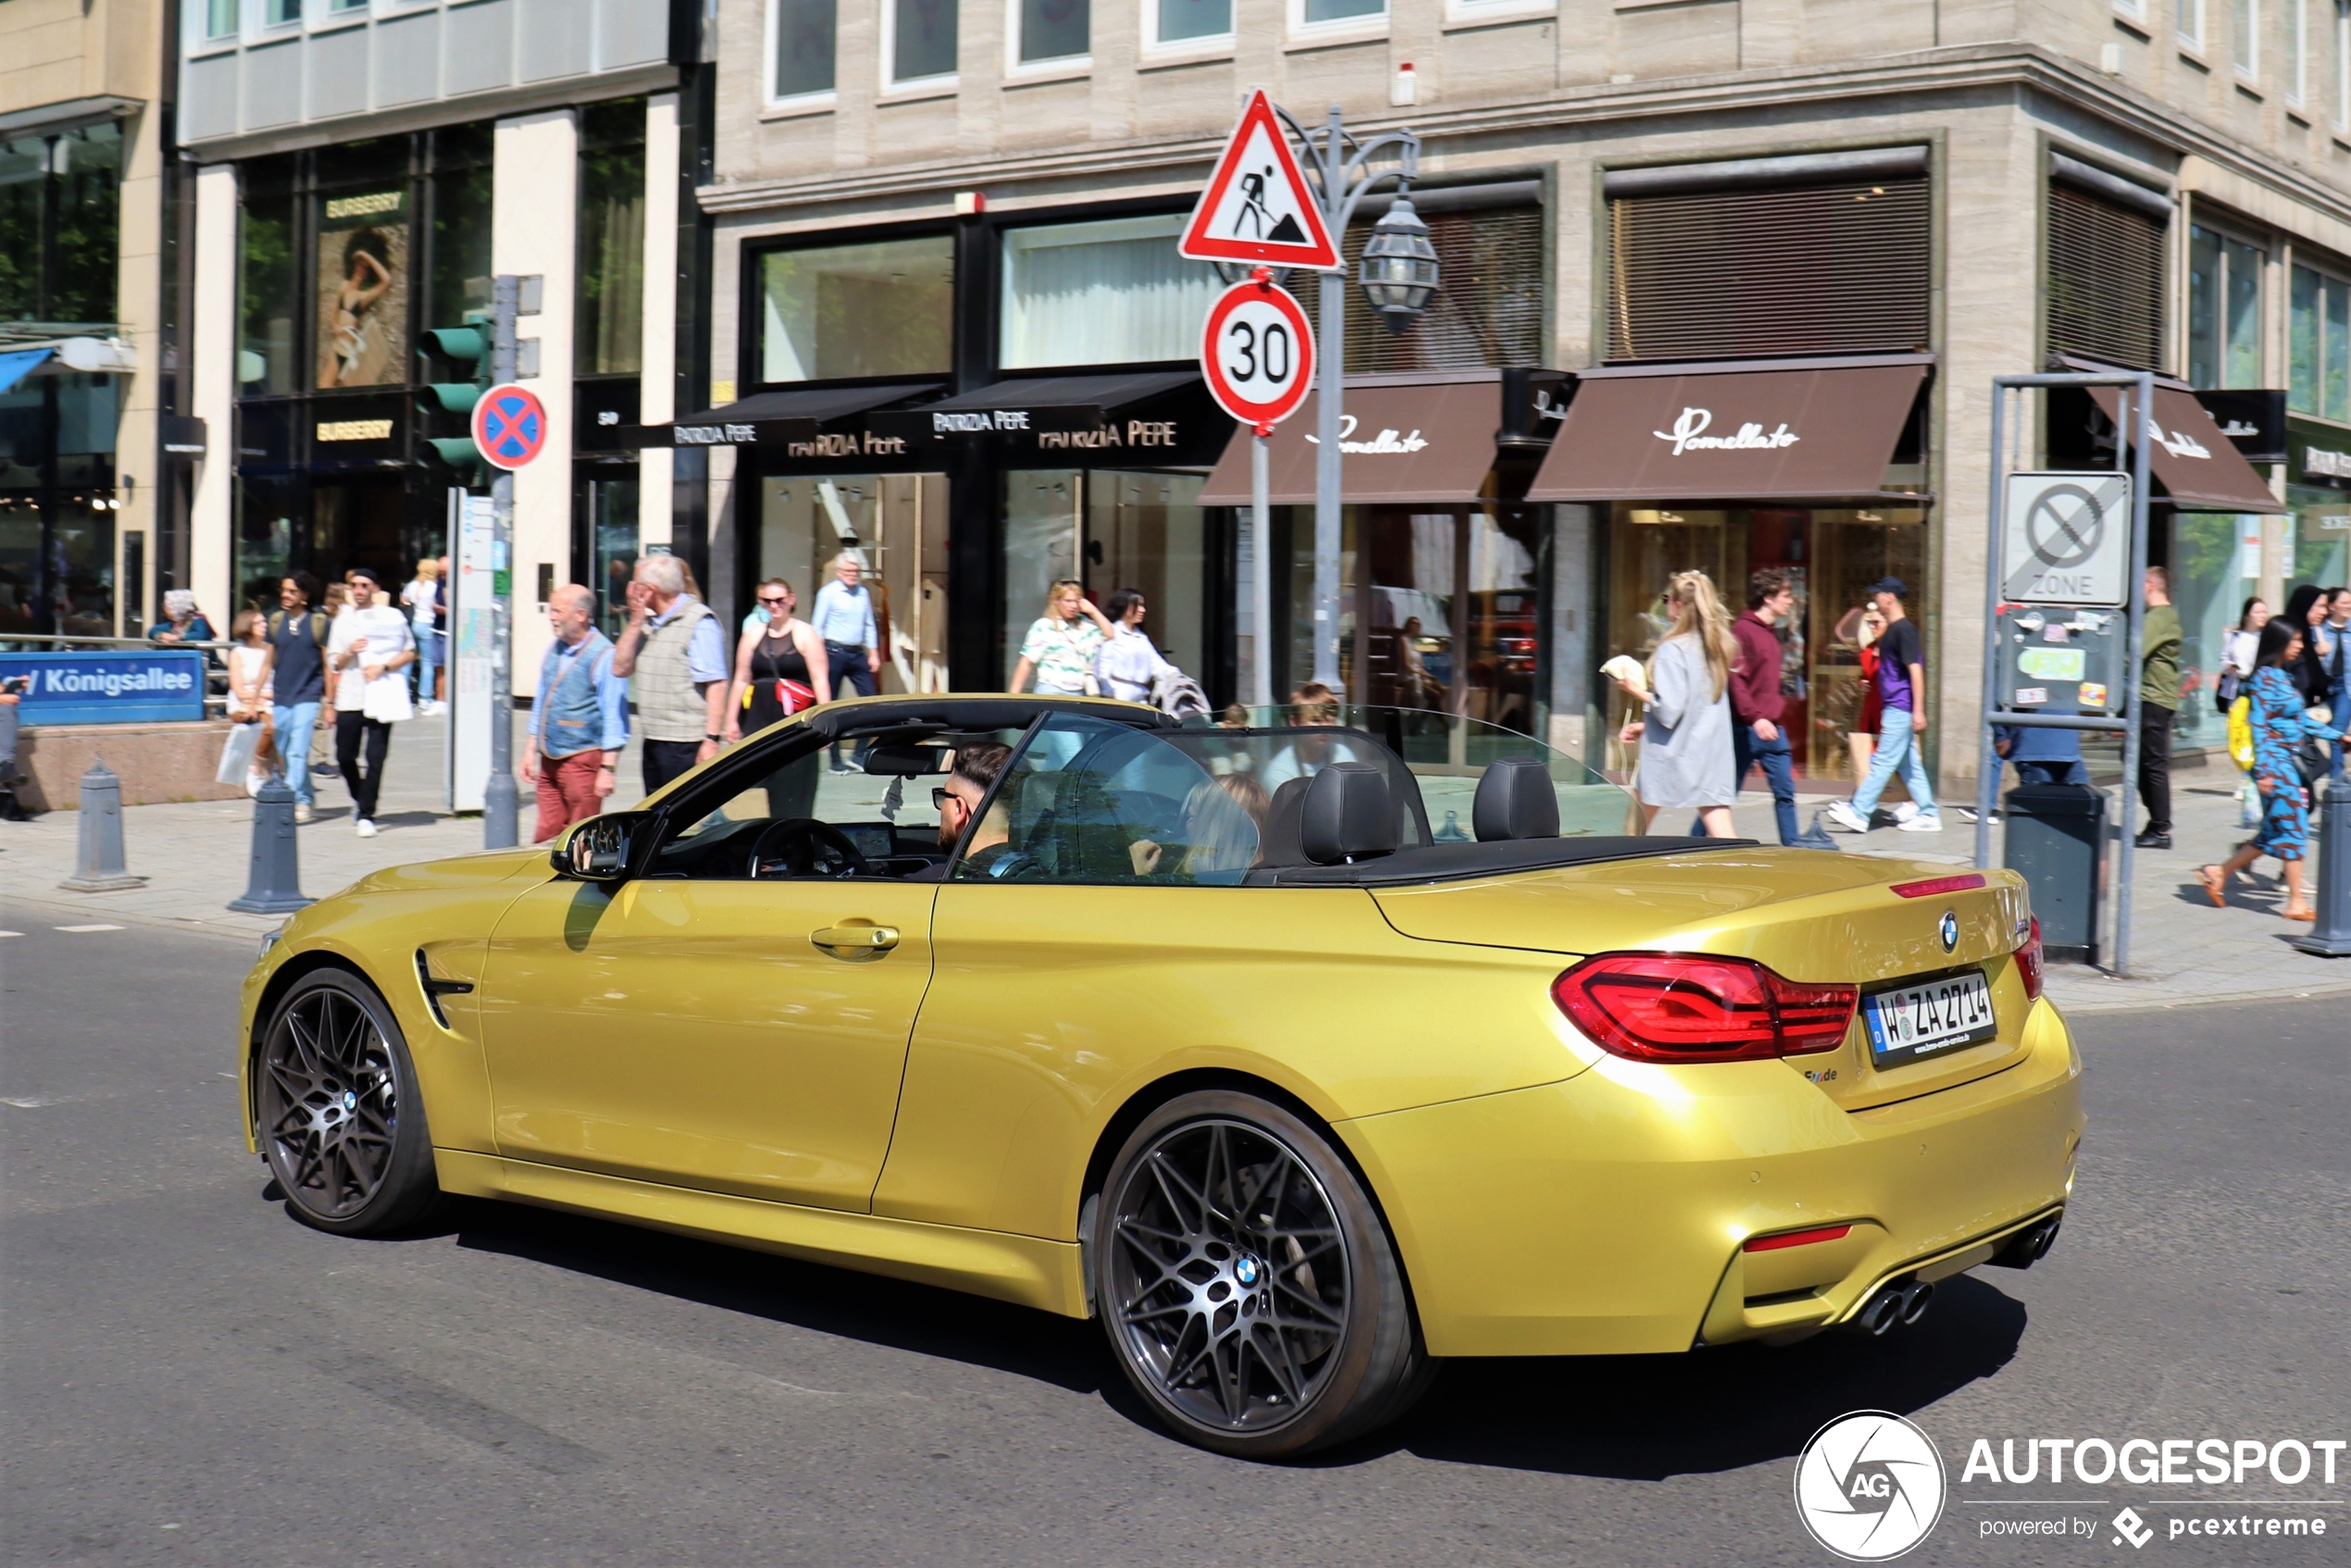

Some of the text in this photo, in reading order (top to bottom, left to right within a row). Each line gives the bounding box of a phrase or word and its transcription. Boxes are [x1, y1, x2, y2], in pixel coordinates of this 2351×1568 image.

[326, 191, 402, 218] BURBERRY
[1230, 320, 1288, 384] 30
[317, 419, 393, 442] BURBERRY
[993, 410, 1030, 430] PEPE
[1127, 420, 1177, 447] PEPE
[1652, 406, 1801, 456] Pomellato
[2033, 574, 2094, 595] ZONE
[45, 667, 193, 696] Königsallee
[1881, 979, 1988, 1042] W ZA 2714
